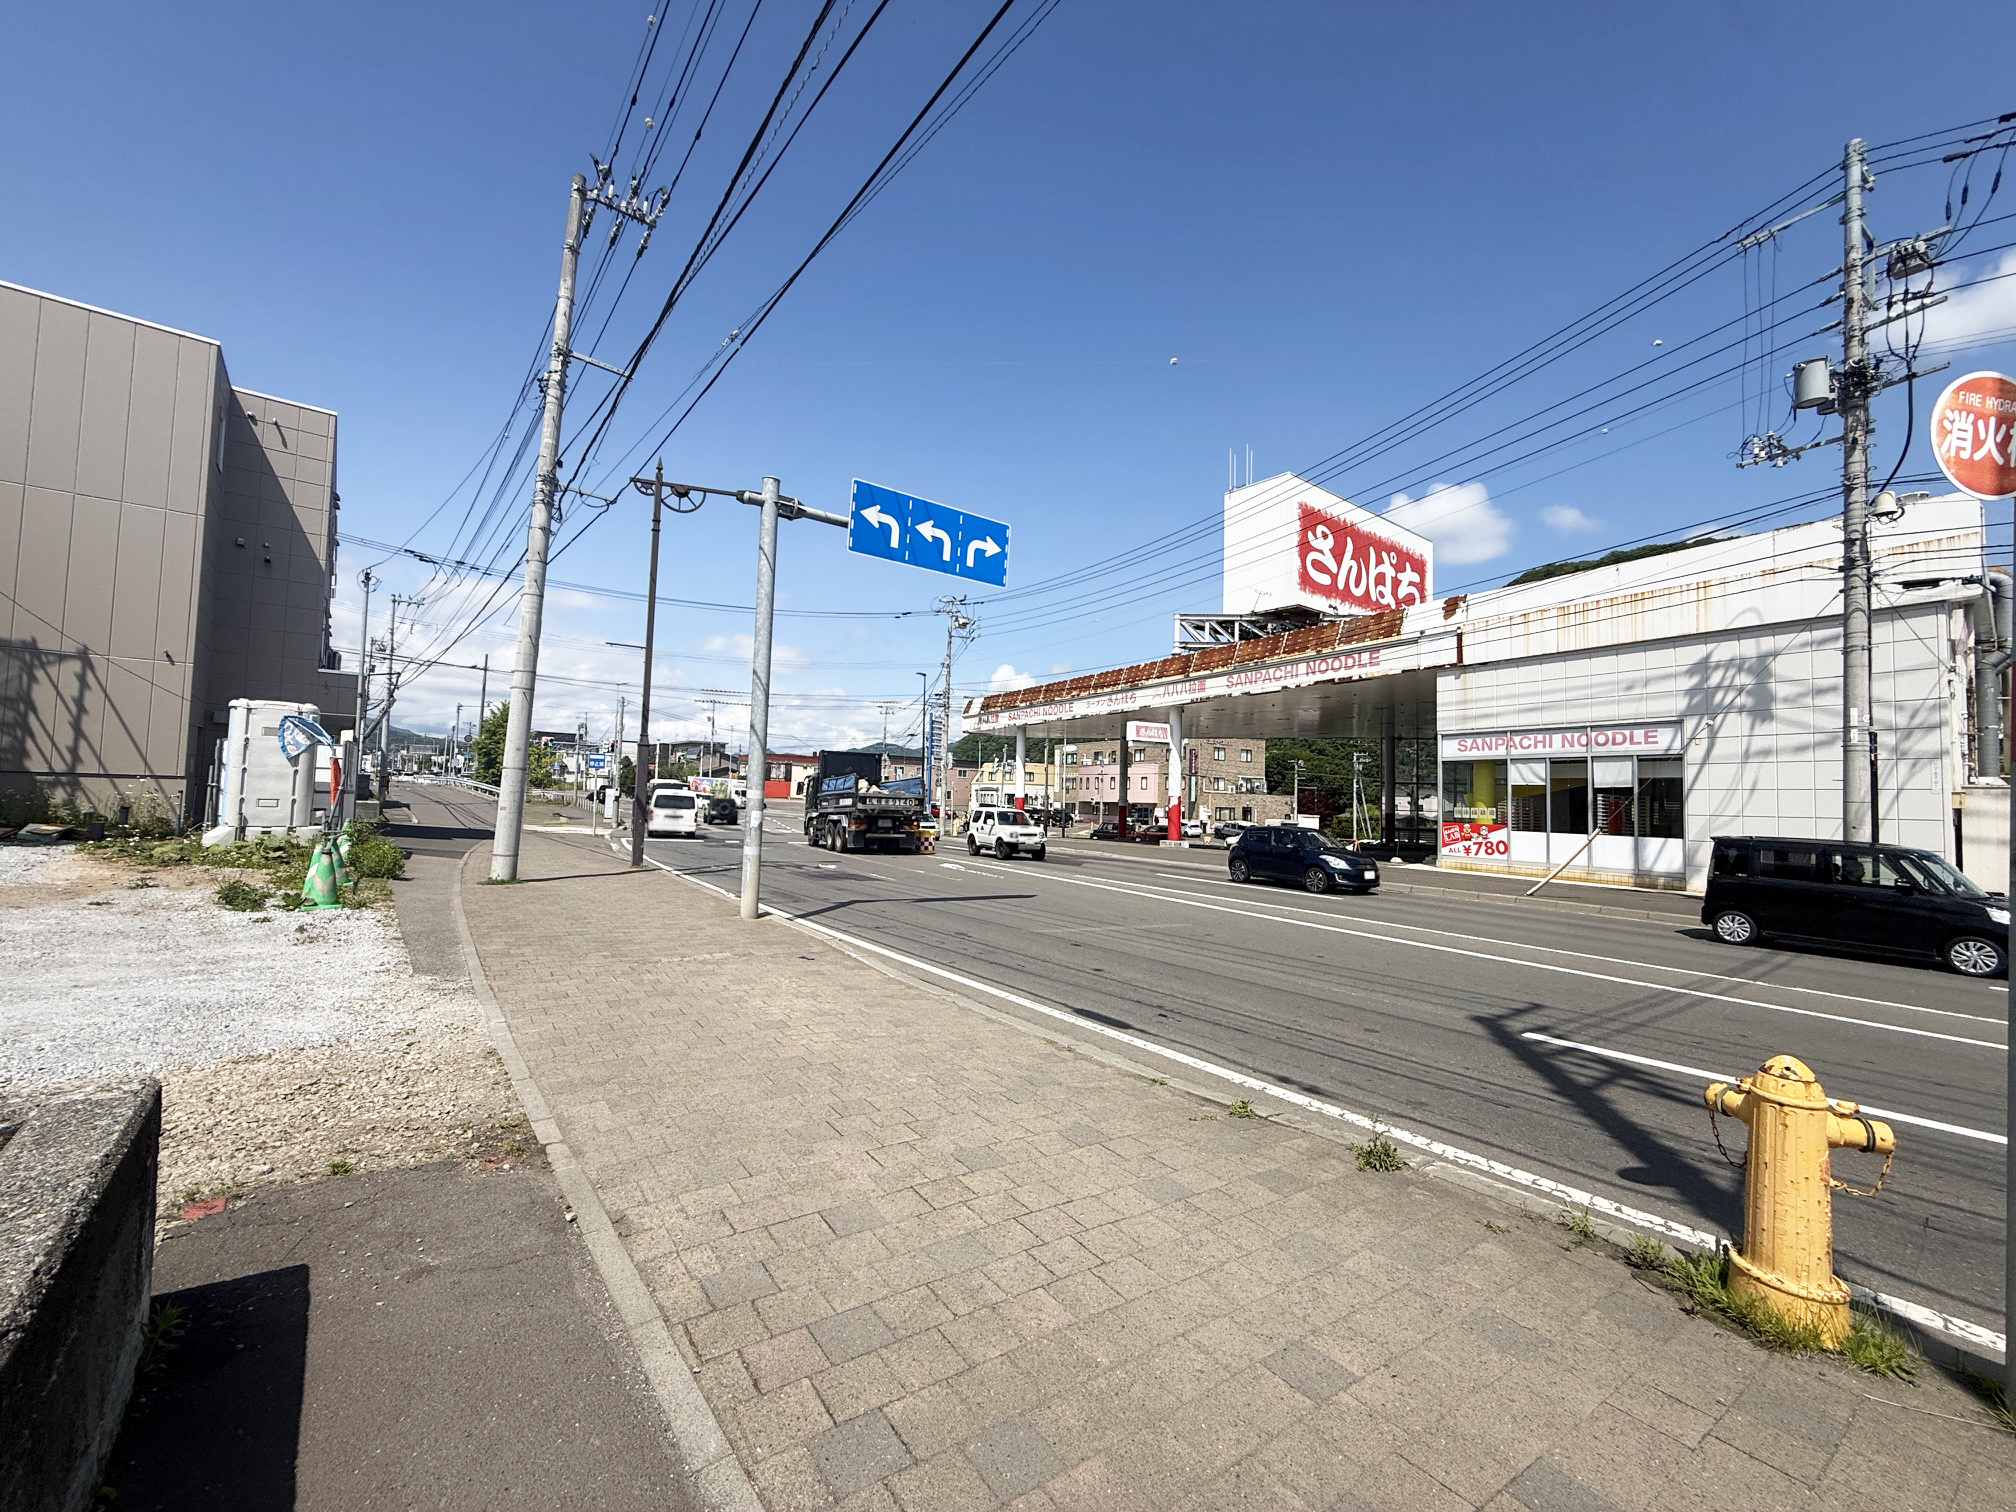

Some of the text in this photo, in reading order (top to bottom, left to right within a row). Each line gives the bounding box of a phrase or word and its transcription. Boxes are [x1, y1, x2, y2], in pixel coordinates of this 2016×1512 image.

[1958, 390, 1983, 407] FIRE
[1305, 524, 1421, 609] さんぱち
[1226, 650, 1381, 689] SANPACHI NOODLE
[1007, 702, 1074, 722] SANPACHI NOODLE
[1457, 729, 1659, 752] SANPACHI NOODLE
[1448, 846, 1461, 854] ALL
